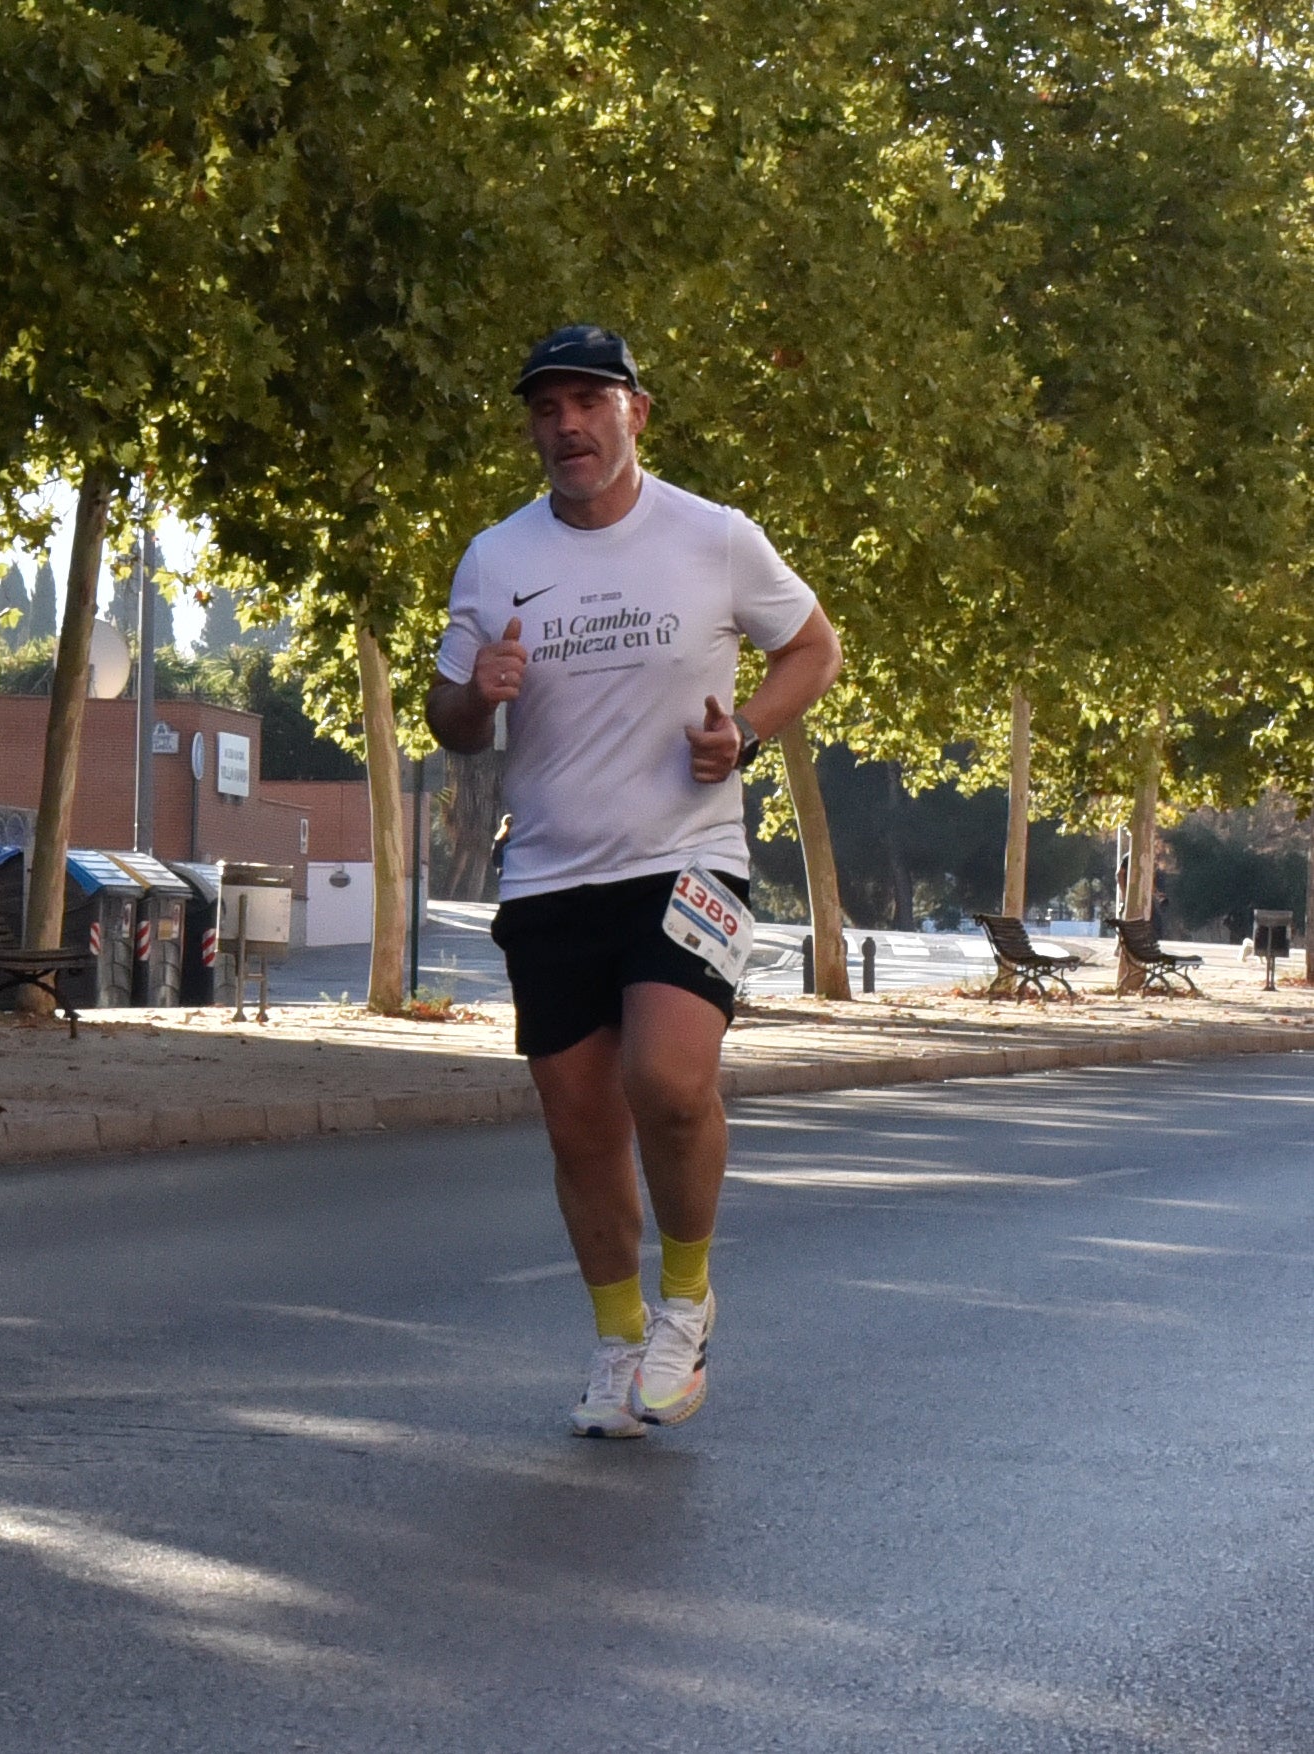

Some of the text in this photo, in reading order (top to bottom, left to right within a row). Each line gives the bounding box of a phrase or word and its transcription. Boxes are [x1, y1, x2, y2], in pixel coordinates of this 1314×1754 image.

[542, 606, 652, 641] El Cambio
[532, 634, 618, 663] empieza
[623, 630, 650, 649] en
[675, 876, 738, 936] 1389
